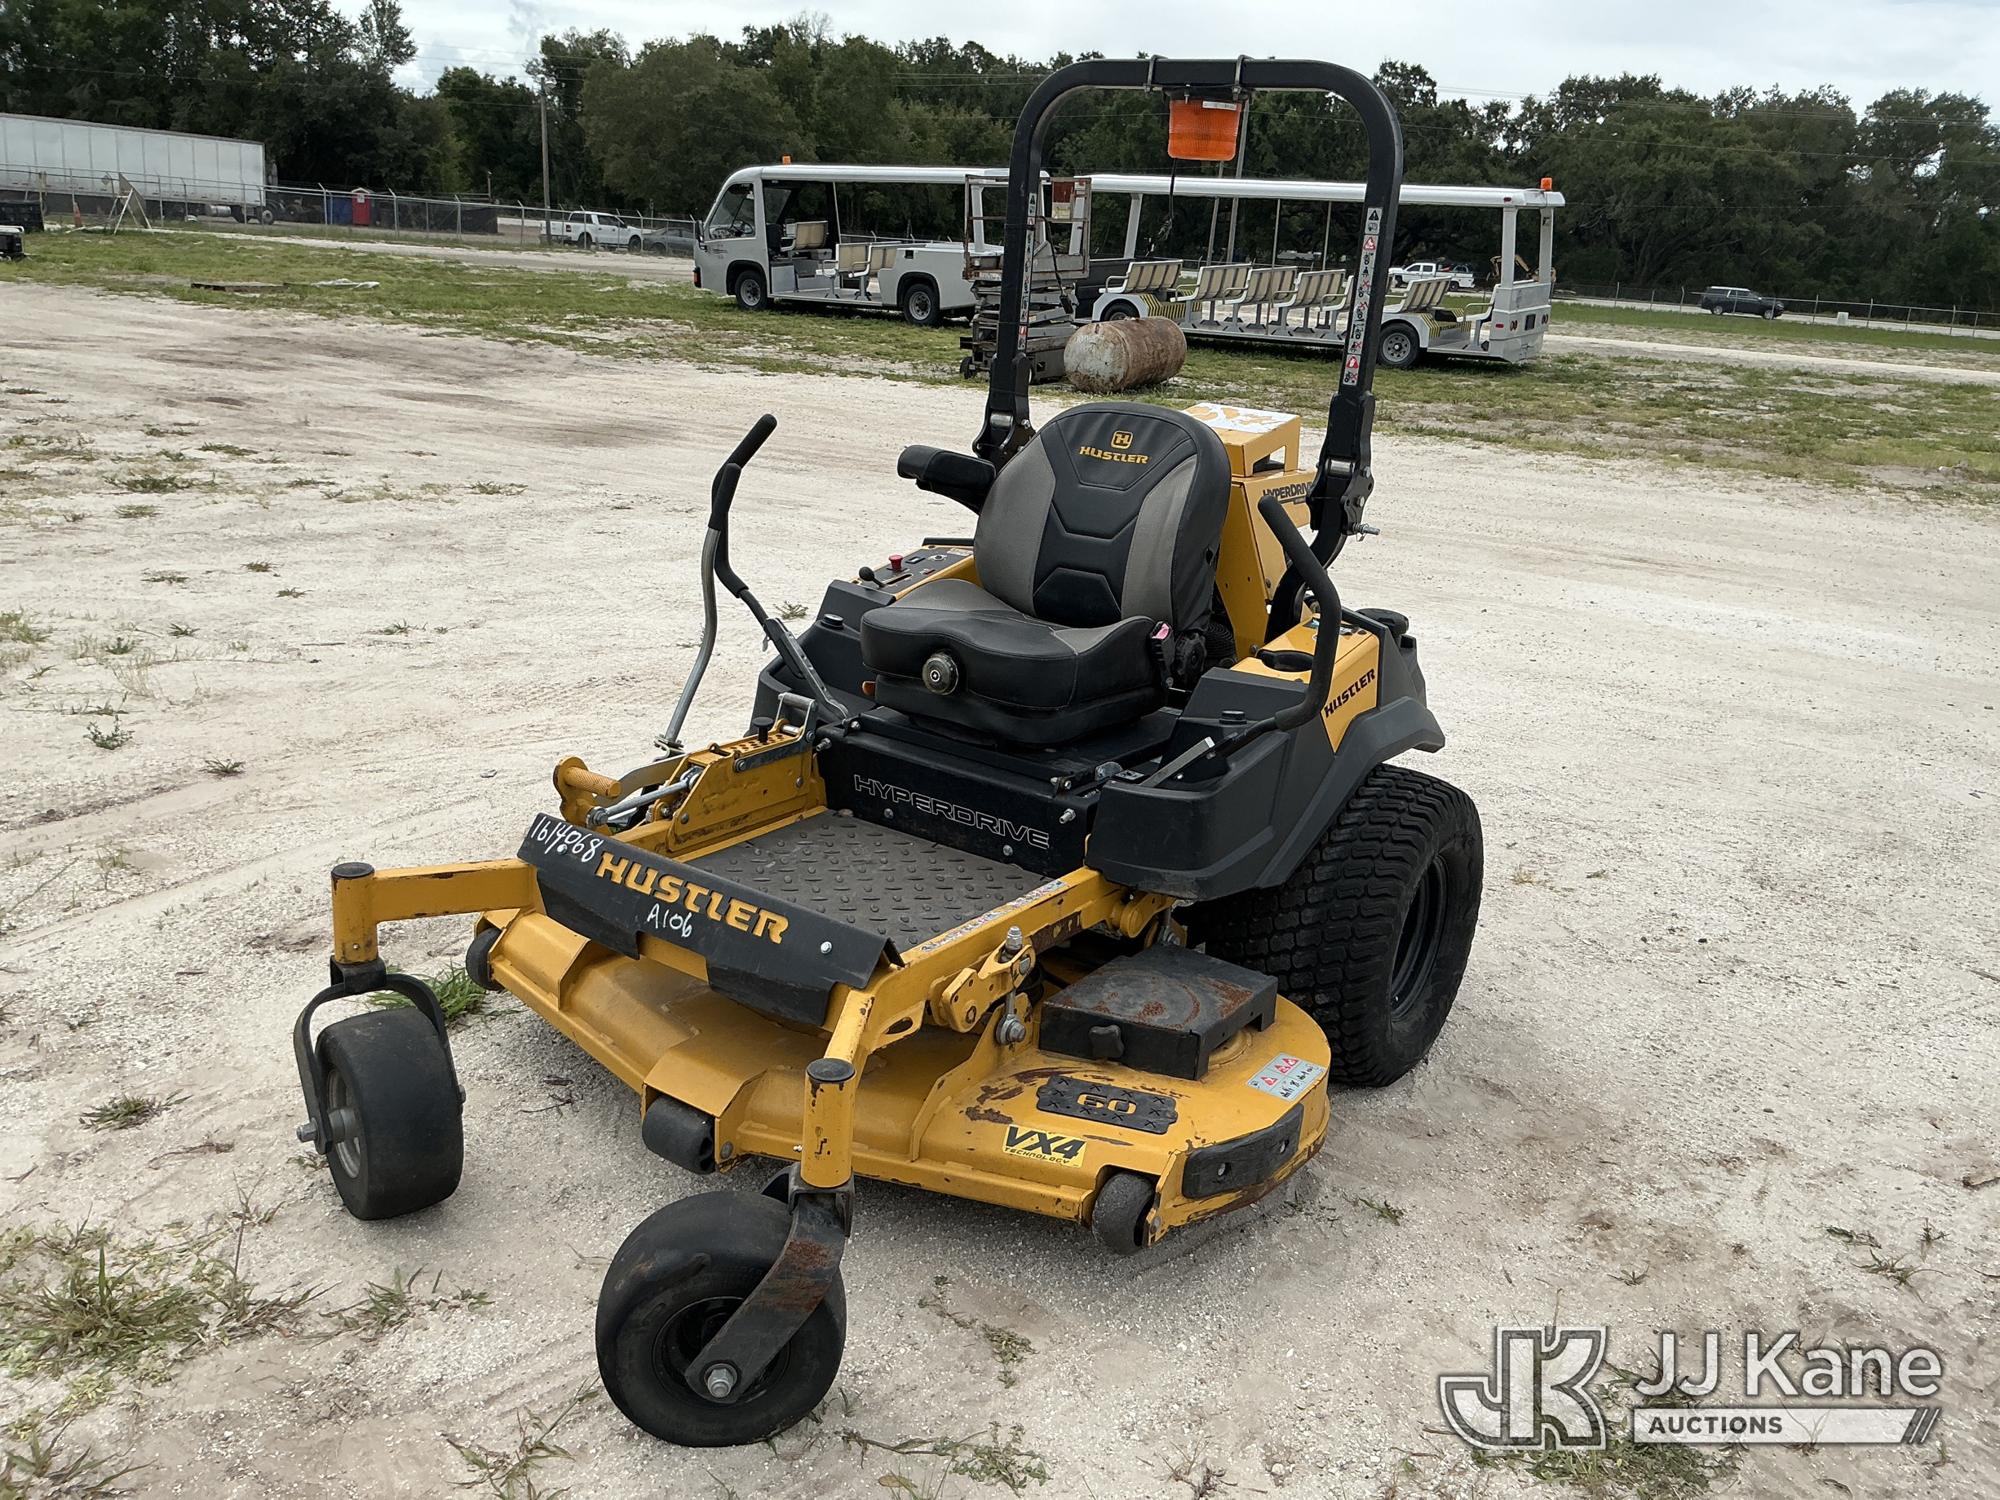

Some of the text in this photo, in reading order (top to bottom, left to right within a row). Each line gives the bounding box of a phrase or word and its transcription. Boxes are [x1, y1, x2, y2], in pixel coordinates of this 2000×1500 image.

[1079, 446, 1149, 464] HUSTLER
[1263, 481, 1313, 499] HYPERDRIV
[1324, 668, 1376, 718] HUSTLER
[854, 774, 1049, 850] HYPERDRIVE
[530, 815, 604, 863] 1614068
[595, 850, 789, 945] HUSTLER
[647, 903, 692, 938] A106
[1077, 1092, 1136, 1115] 60
[1004, 1147, 1070, 1165] TECHNOLOGY
[1005, 1126, 1086, 1160] VX4
